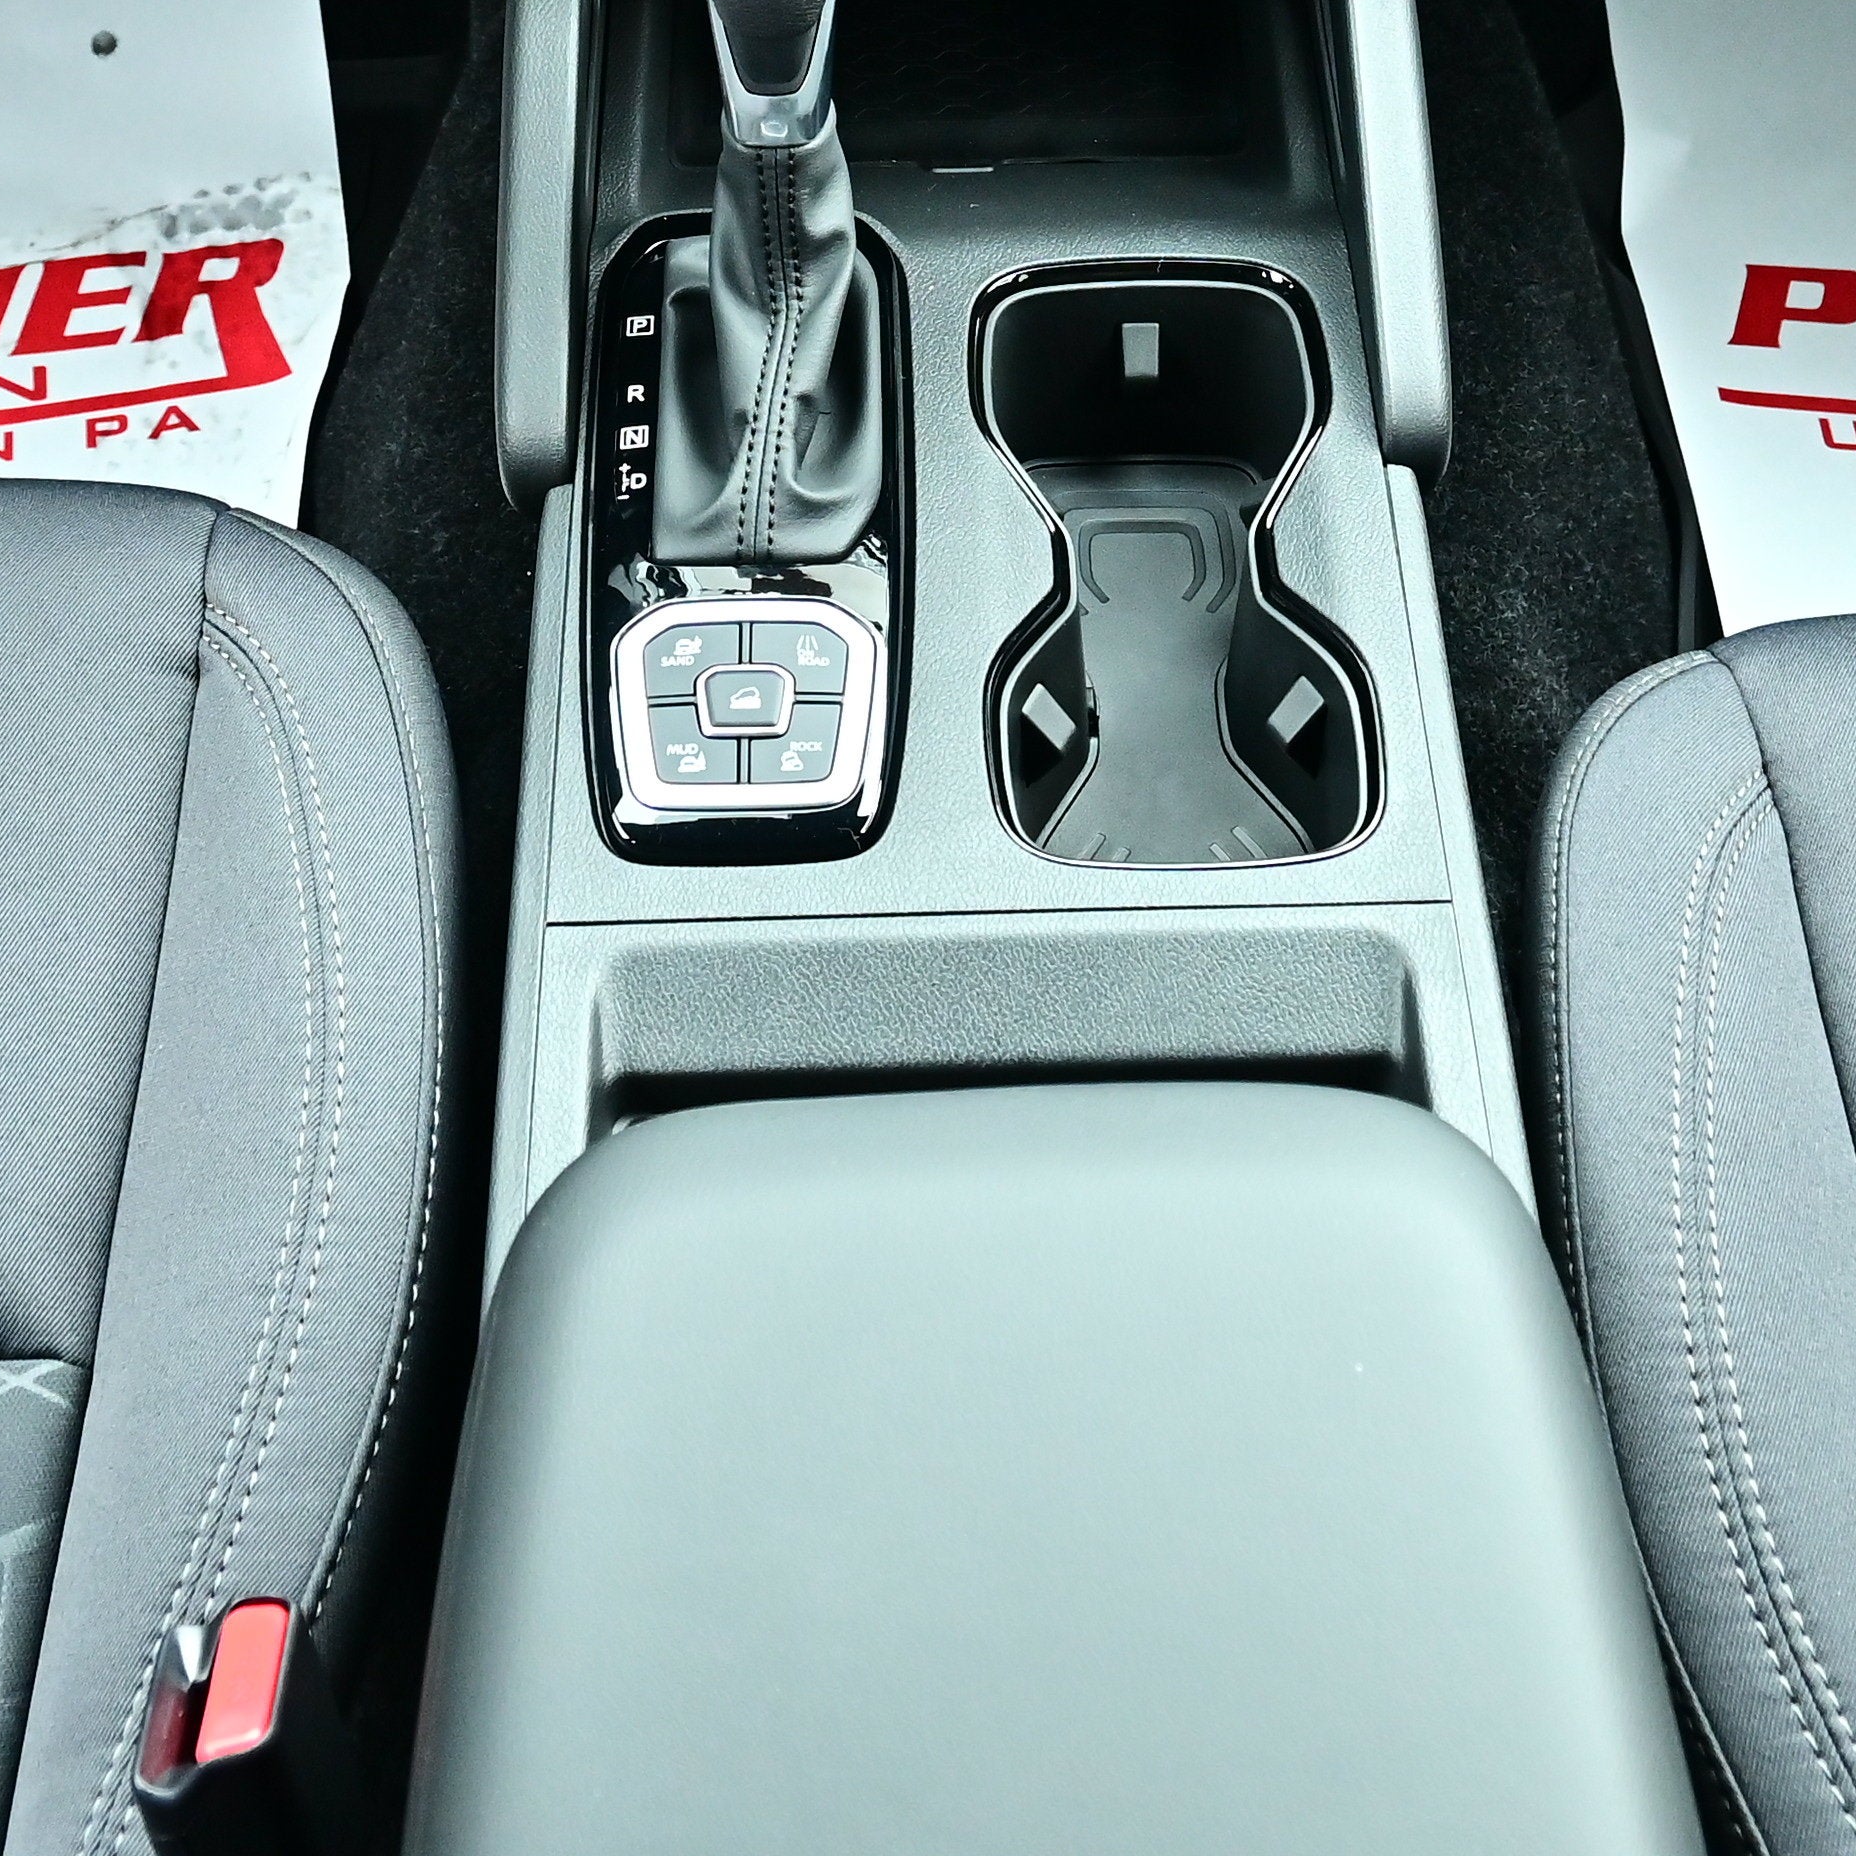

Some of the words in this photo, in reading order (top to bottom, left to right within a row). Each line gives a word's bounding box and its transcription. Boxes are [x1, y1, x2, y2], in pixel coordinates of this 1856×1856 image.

[632, 317, 648, 334] P
[627, 384, 645, 403] R
[87, 405, 202, 449] PA
[625, 429, 643, 445] N
[630, 473, 647, 490] D
[660, 655, 695, 667] SAND
[666, 743, 699, 756] MUD
